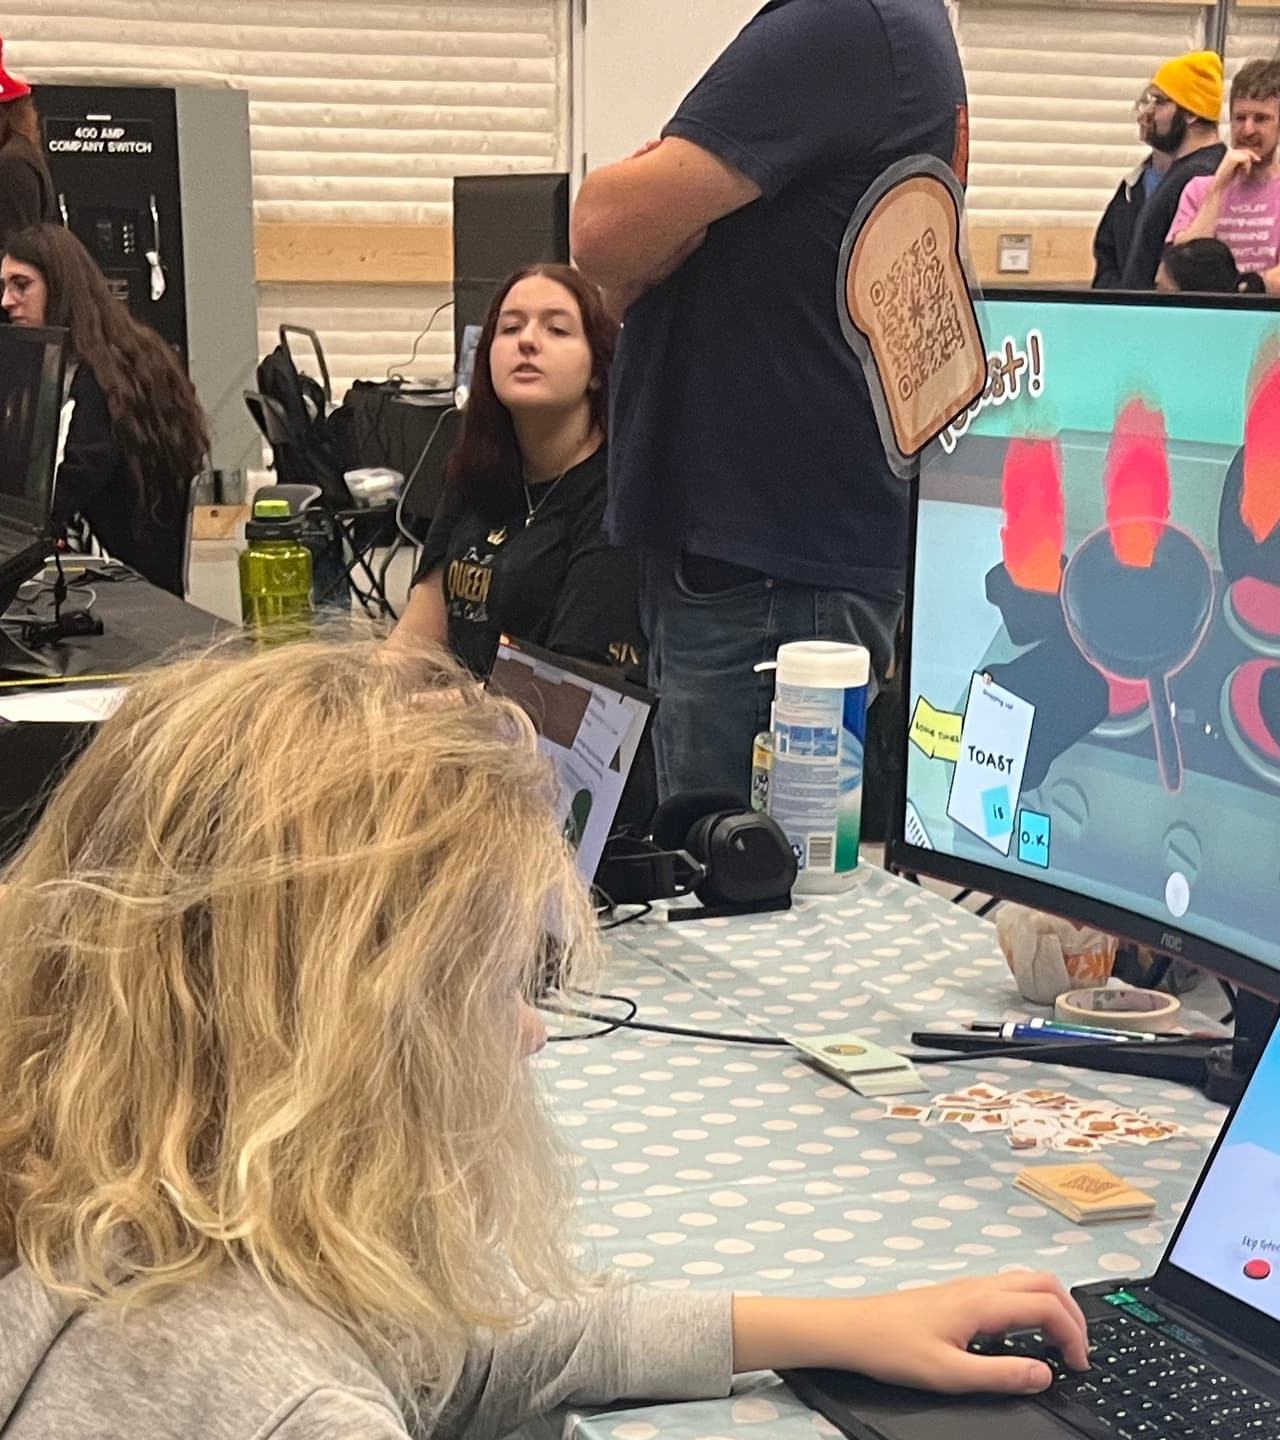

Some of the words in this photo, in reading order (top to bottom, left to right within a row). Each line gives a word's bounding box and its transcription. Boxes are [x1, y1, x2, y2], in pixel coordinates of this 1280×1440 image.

[75, 127, 98, 139] 400
[100, 128, 125, 139] AMP
[49, 141, 105, 152] COMPANY
[107, 142, 152, 153] SWITCH
[448, 560, 493, 602] QUEEN
[968, 745, 1014, 775] TOAST
